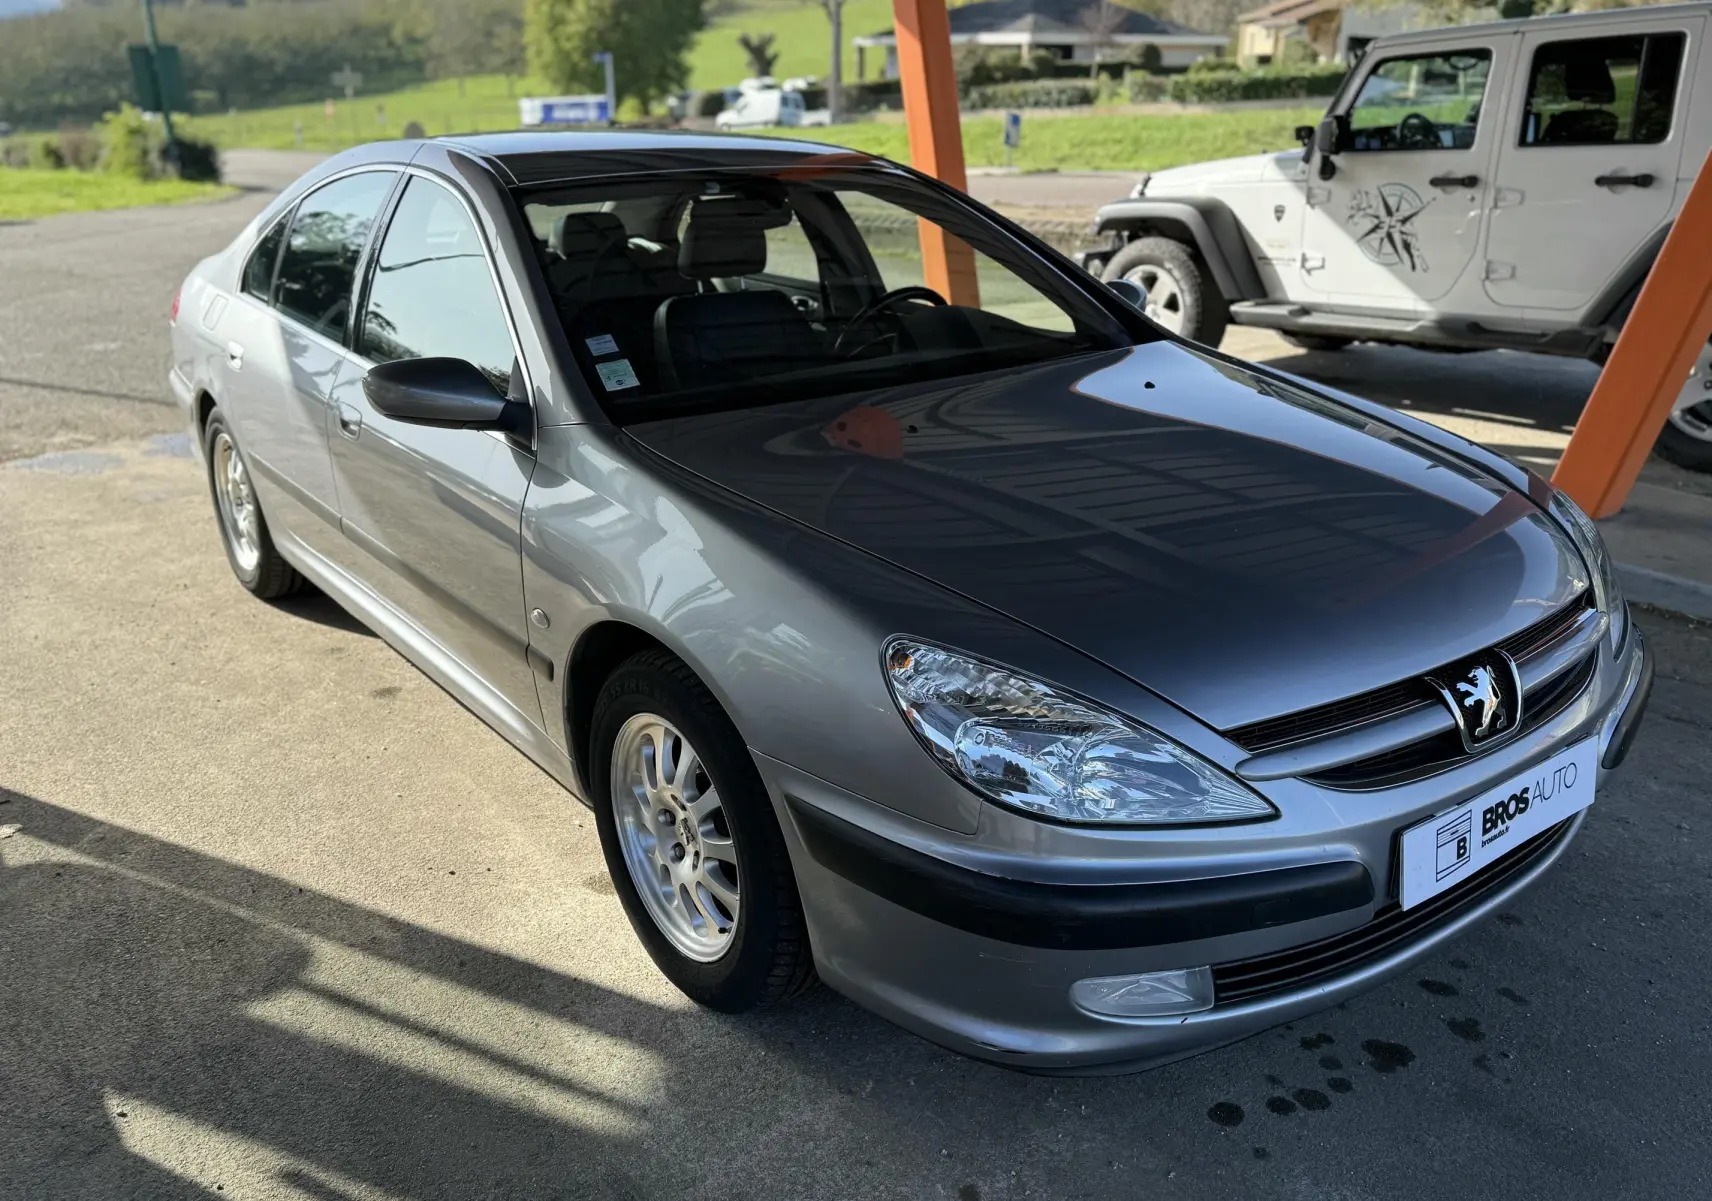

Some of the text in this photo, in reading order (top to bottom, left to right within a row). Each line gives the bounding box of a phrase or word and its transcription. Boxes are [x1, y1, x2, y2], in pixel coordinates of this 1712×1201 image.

[1482, 762, 1578, 837] BROS AUTO
[1456, 836, 1468, 860] B
